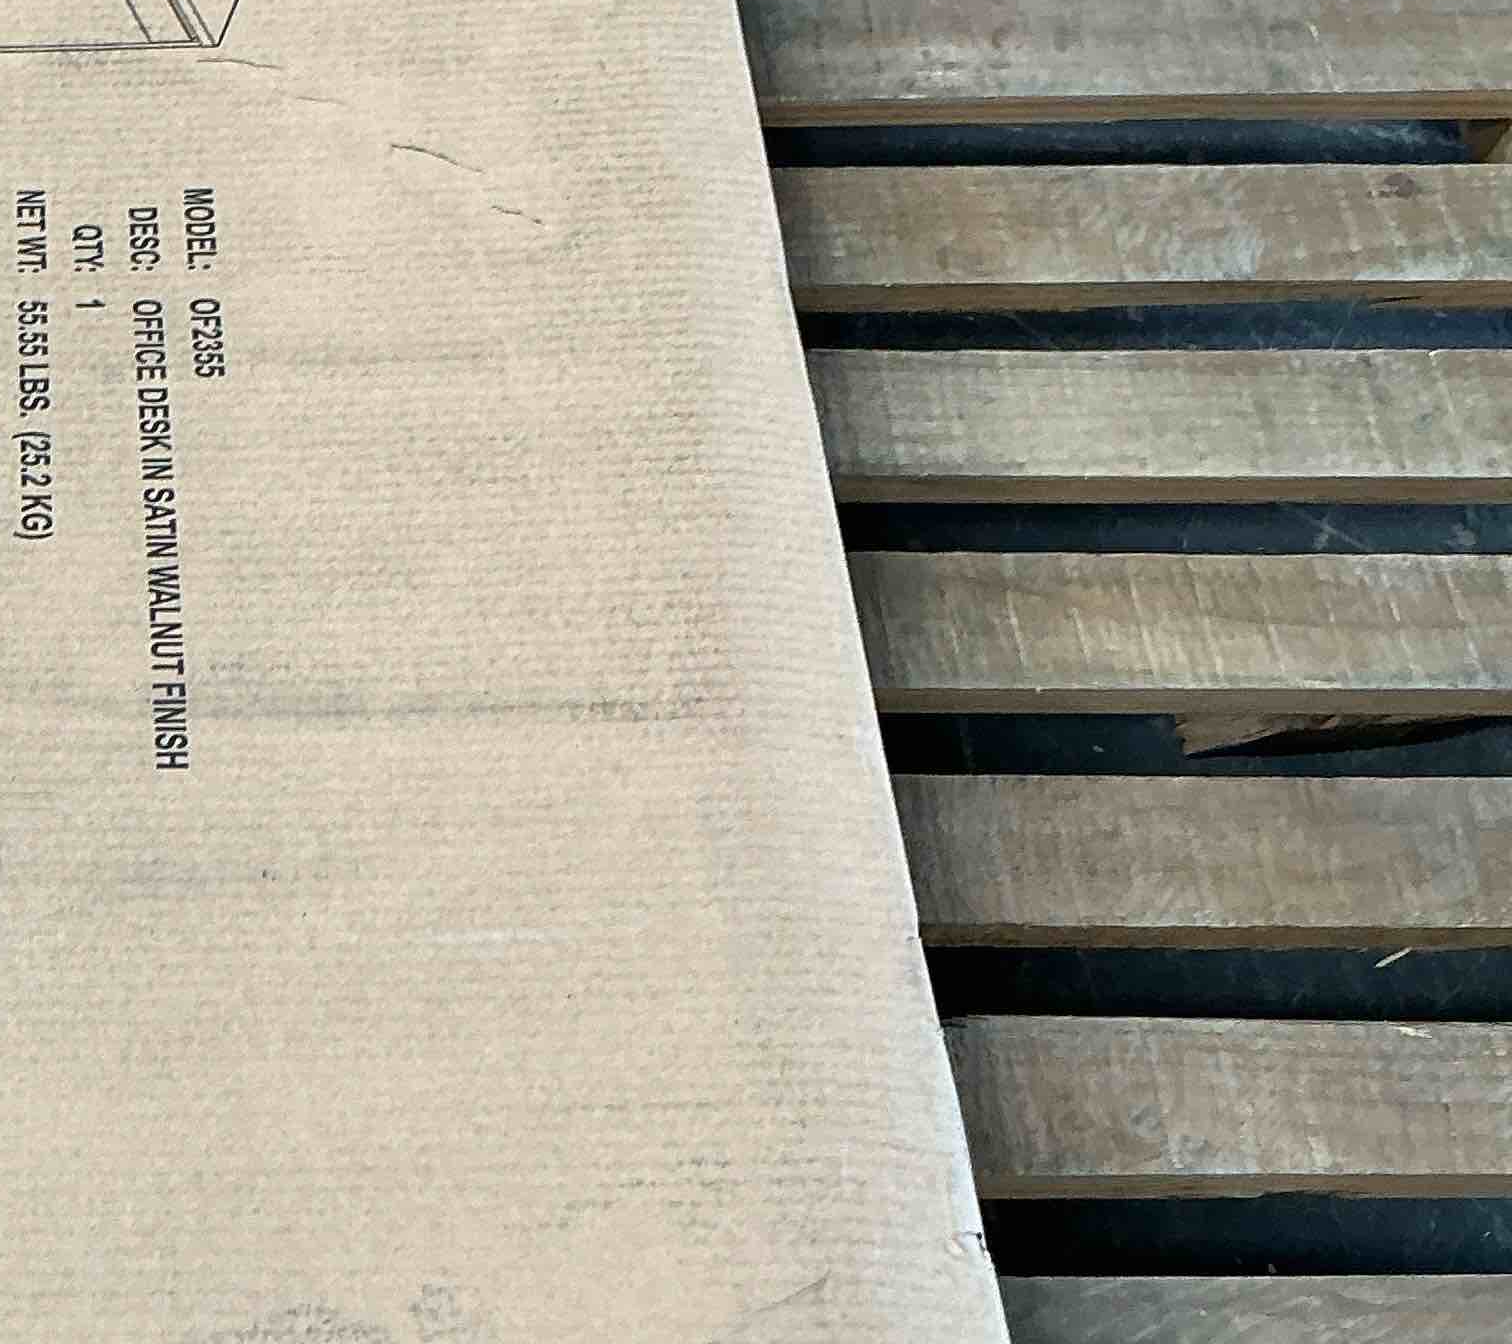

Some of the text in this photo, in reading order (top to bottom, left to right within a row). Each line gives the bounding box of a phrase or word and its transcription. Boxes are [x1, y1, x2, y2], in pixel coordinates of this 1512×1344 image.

[13, 189, 53, 540] NET WT: 55.55 LBS. (25.2 KG)
[72, 224, 105, 309] QTY: 1
[184, 187, 225, 378] MODEL: OF2355
[128, 206, 190, 770] DESC: OFFICE DESK IN SATIN WALNUT FINISH
